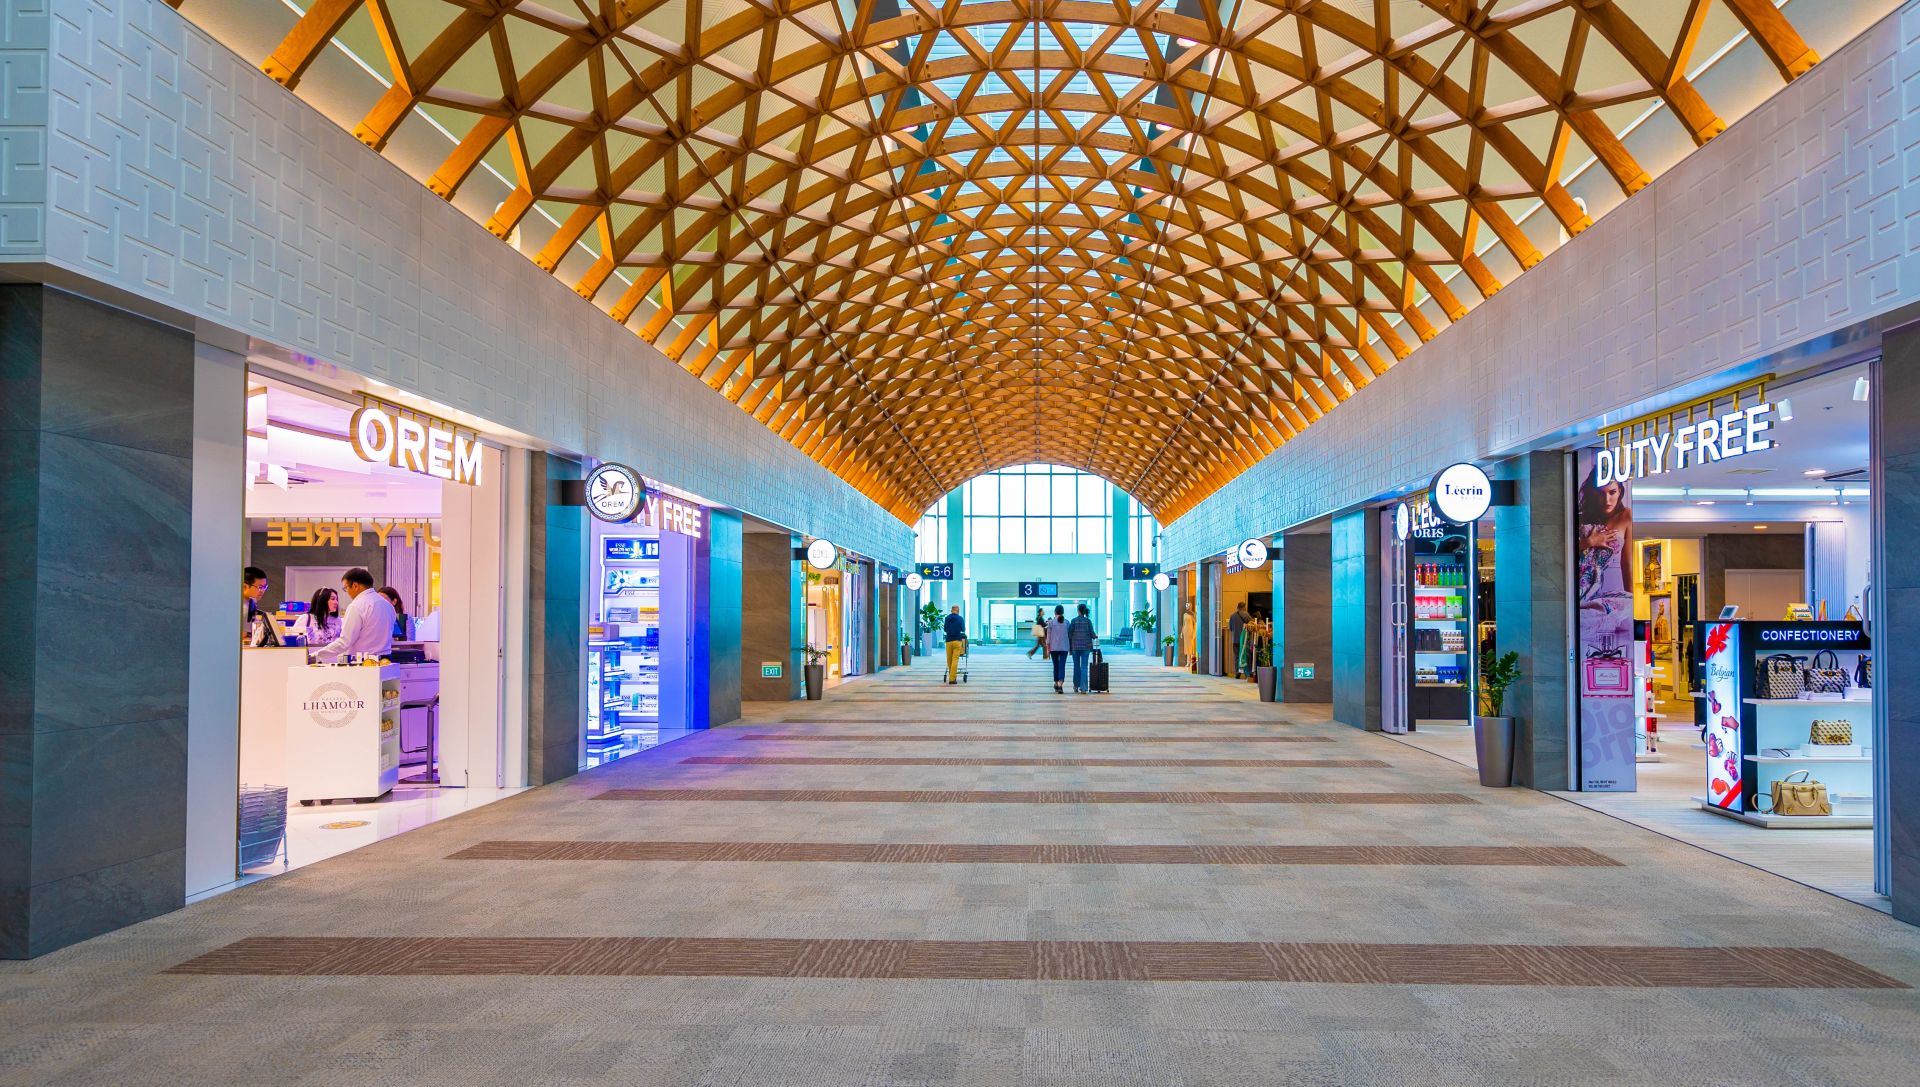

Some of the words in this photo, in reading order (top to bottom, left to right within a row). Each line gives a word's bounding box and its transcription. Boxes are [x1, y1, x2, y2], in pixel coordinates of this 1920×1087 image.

[354, 406, 482, 486] OREM
[1596, 432, 1671, 487] DUTY
[1677, 403, 1772, 468] FREE
[663, 500, 702, 538] FREE
[1130, 566, 1136, 577] 1
[1024, 583, 1033, 596] 3
[1761, 630, 1860, 641] CONFECTIONERY
[765, 667, 779, 676] EXIT
[1711, 665, 1735, 682] Belgian
[303, 700, 365, 711] LHAMOUR
